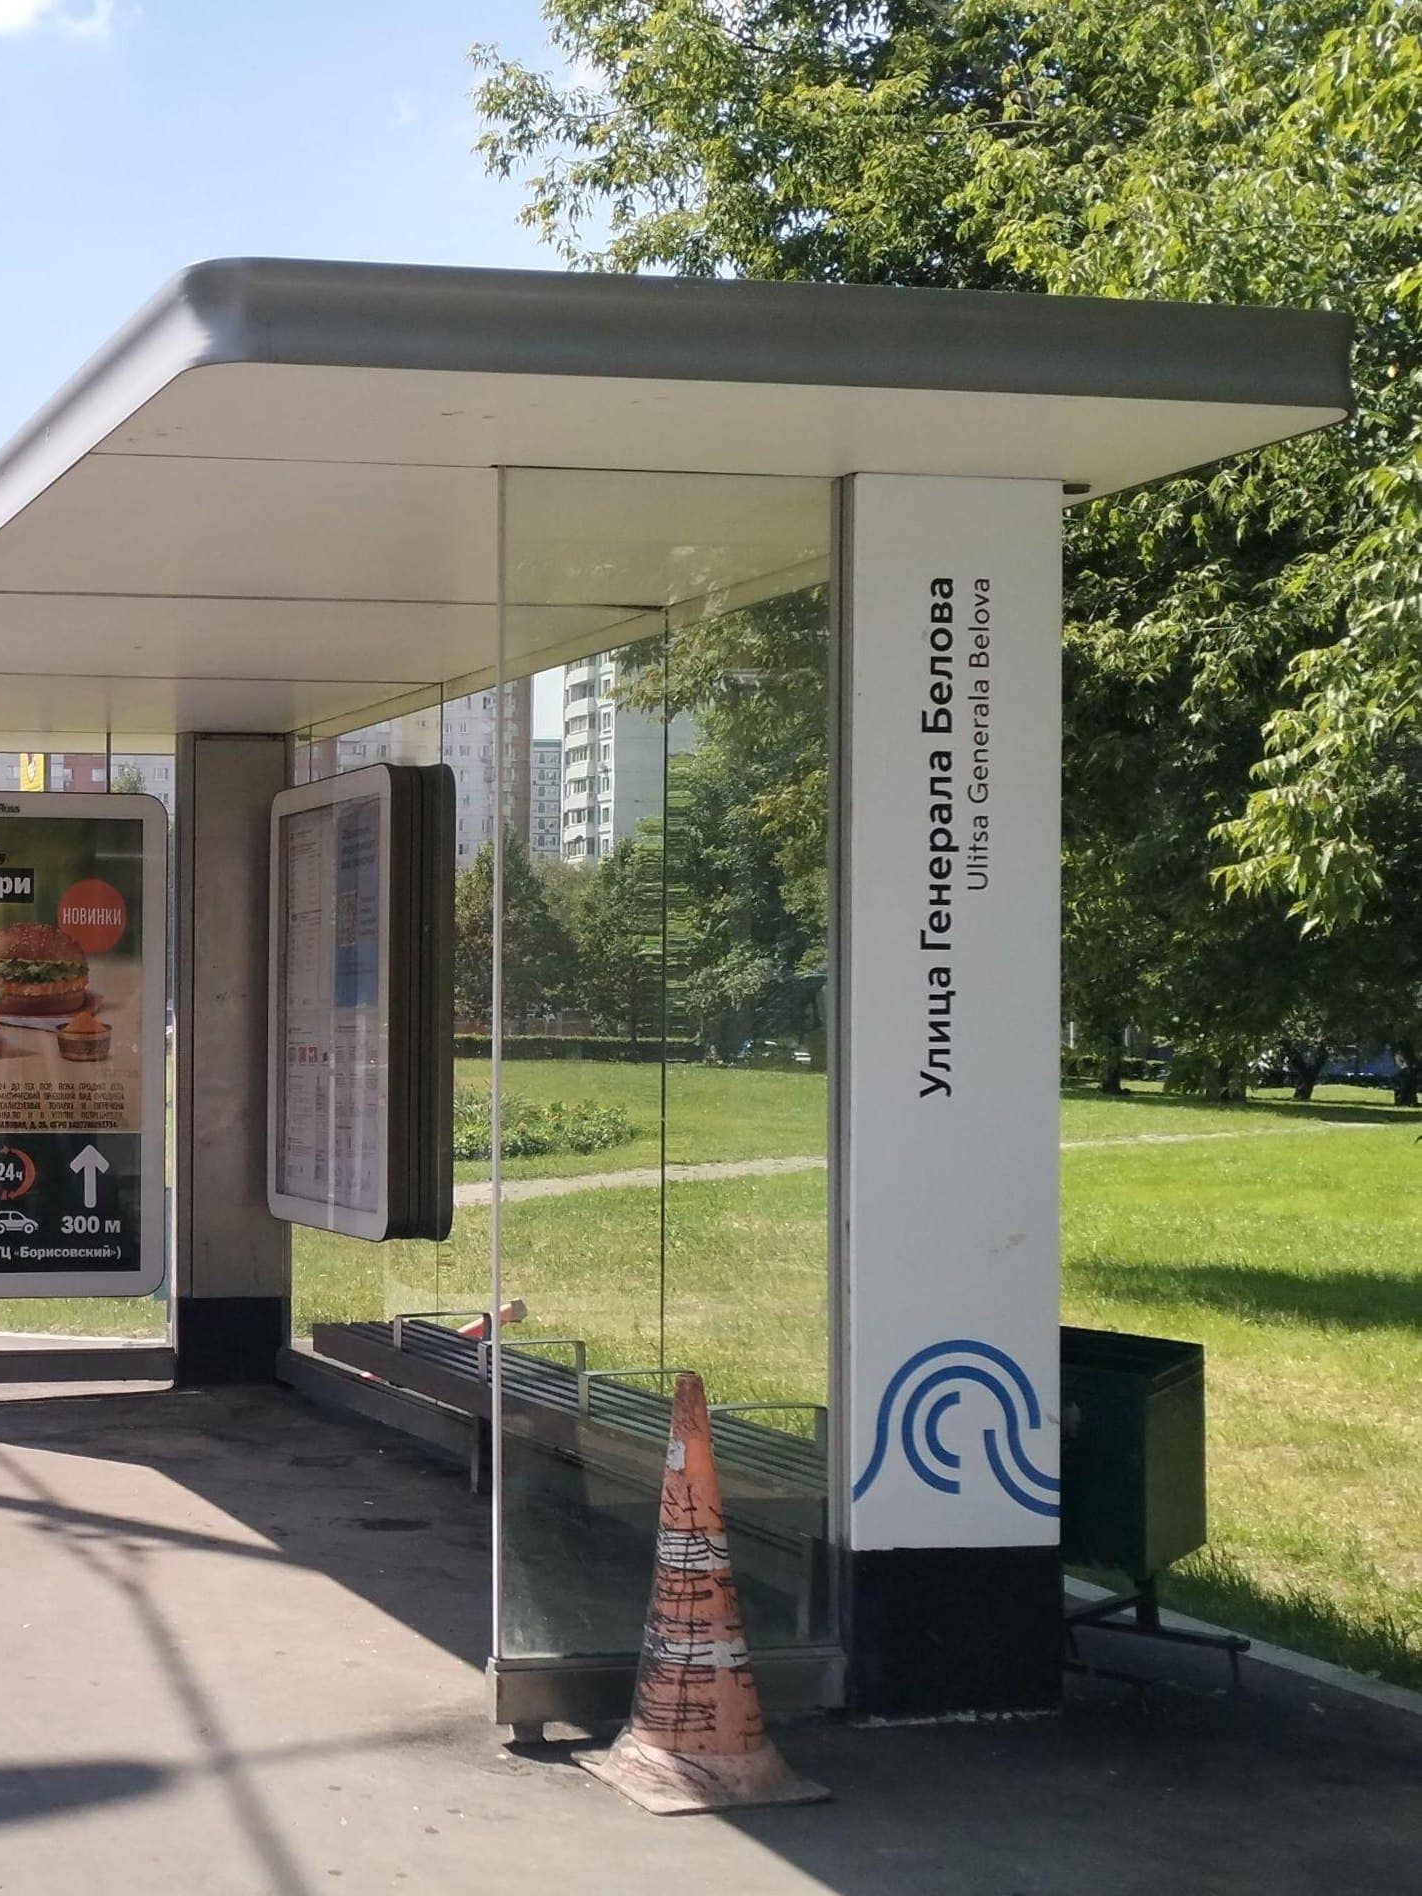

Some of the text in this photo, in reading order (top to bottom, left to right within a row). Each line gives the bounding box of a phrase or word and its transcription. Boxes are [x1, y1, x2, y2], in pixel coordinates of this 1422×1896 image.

[967, 578, 990, 891] Ulitsa Generala Belova
[62, 907, 122, 926] НОВИНКИ
[920, 576, 960, 1097] Улица Генерала Белова
[61, 1216, 121, 1234] 300 м
